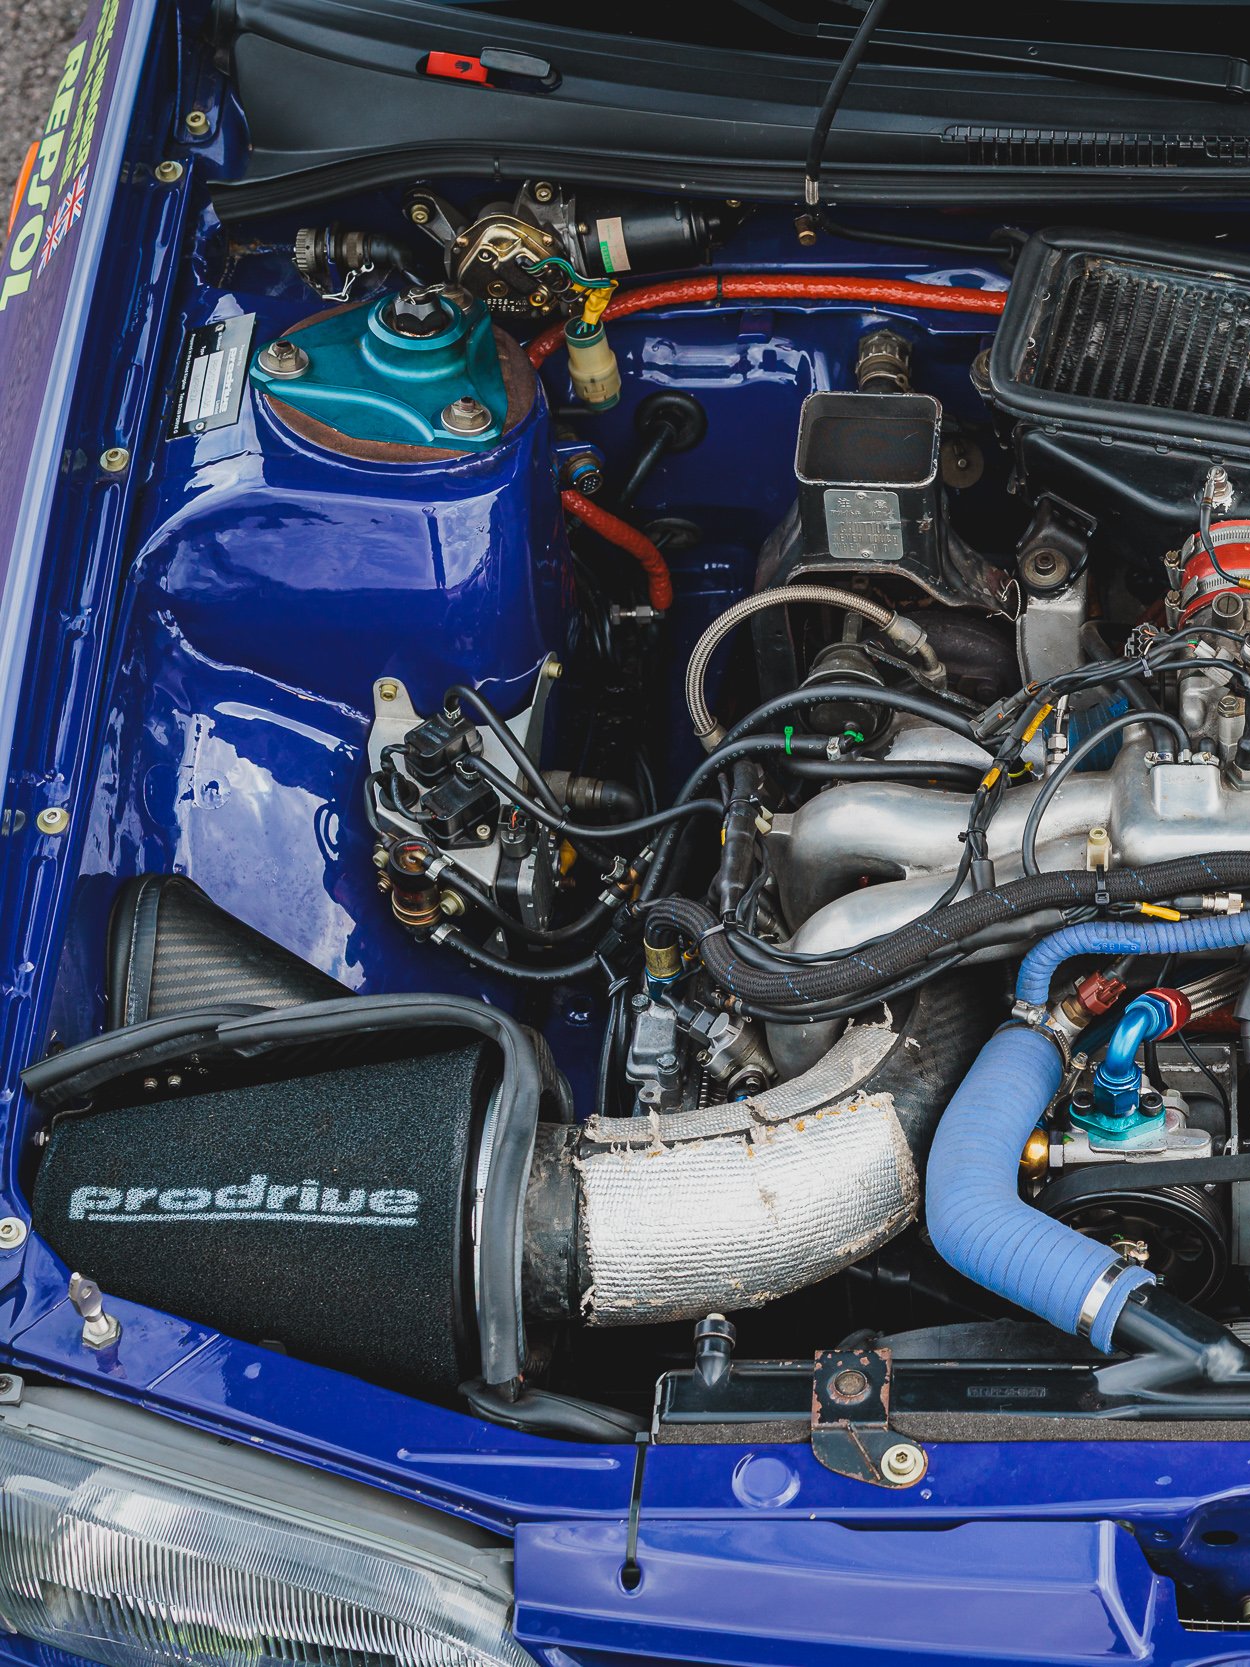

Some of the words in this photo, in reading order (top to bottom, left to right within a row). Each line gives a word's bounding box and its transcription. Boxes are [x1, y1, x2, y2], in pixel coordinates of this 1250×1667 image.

[0, 40, 87, 312] REPSOL
[73, 49, 110, 180] RINGER
[69, 1173, 419, 1219] prodrive
